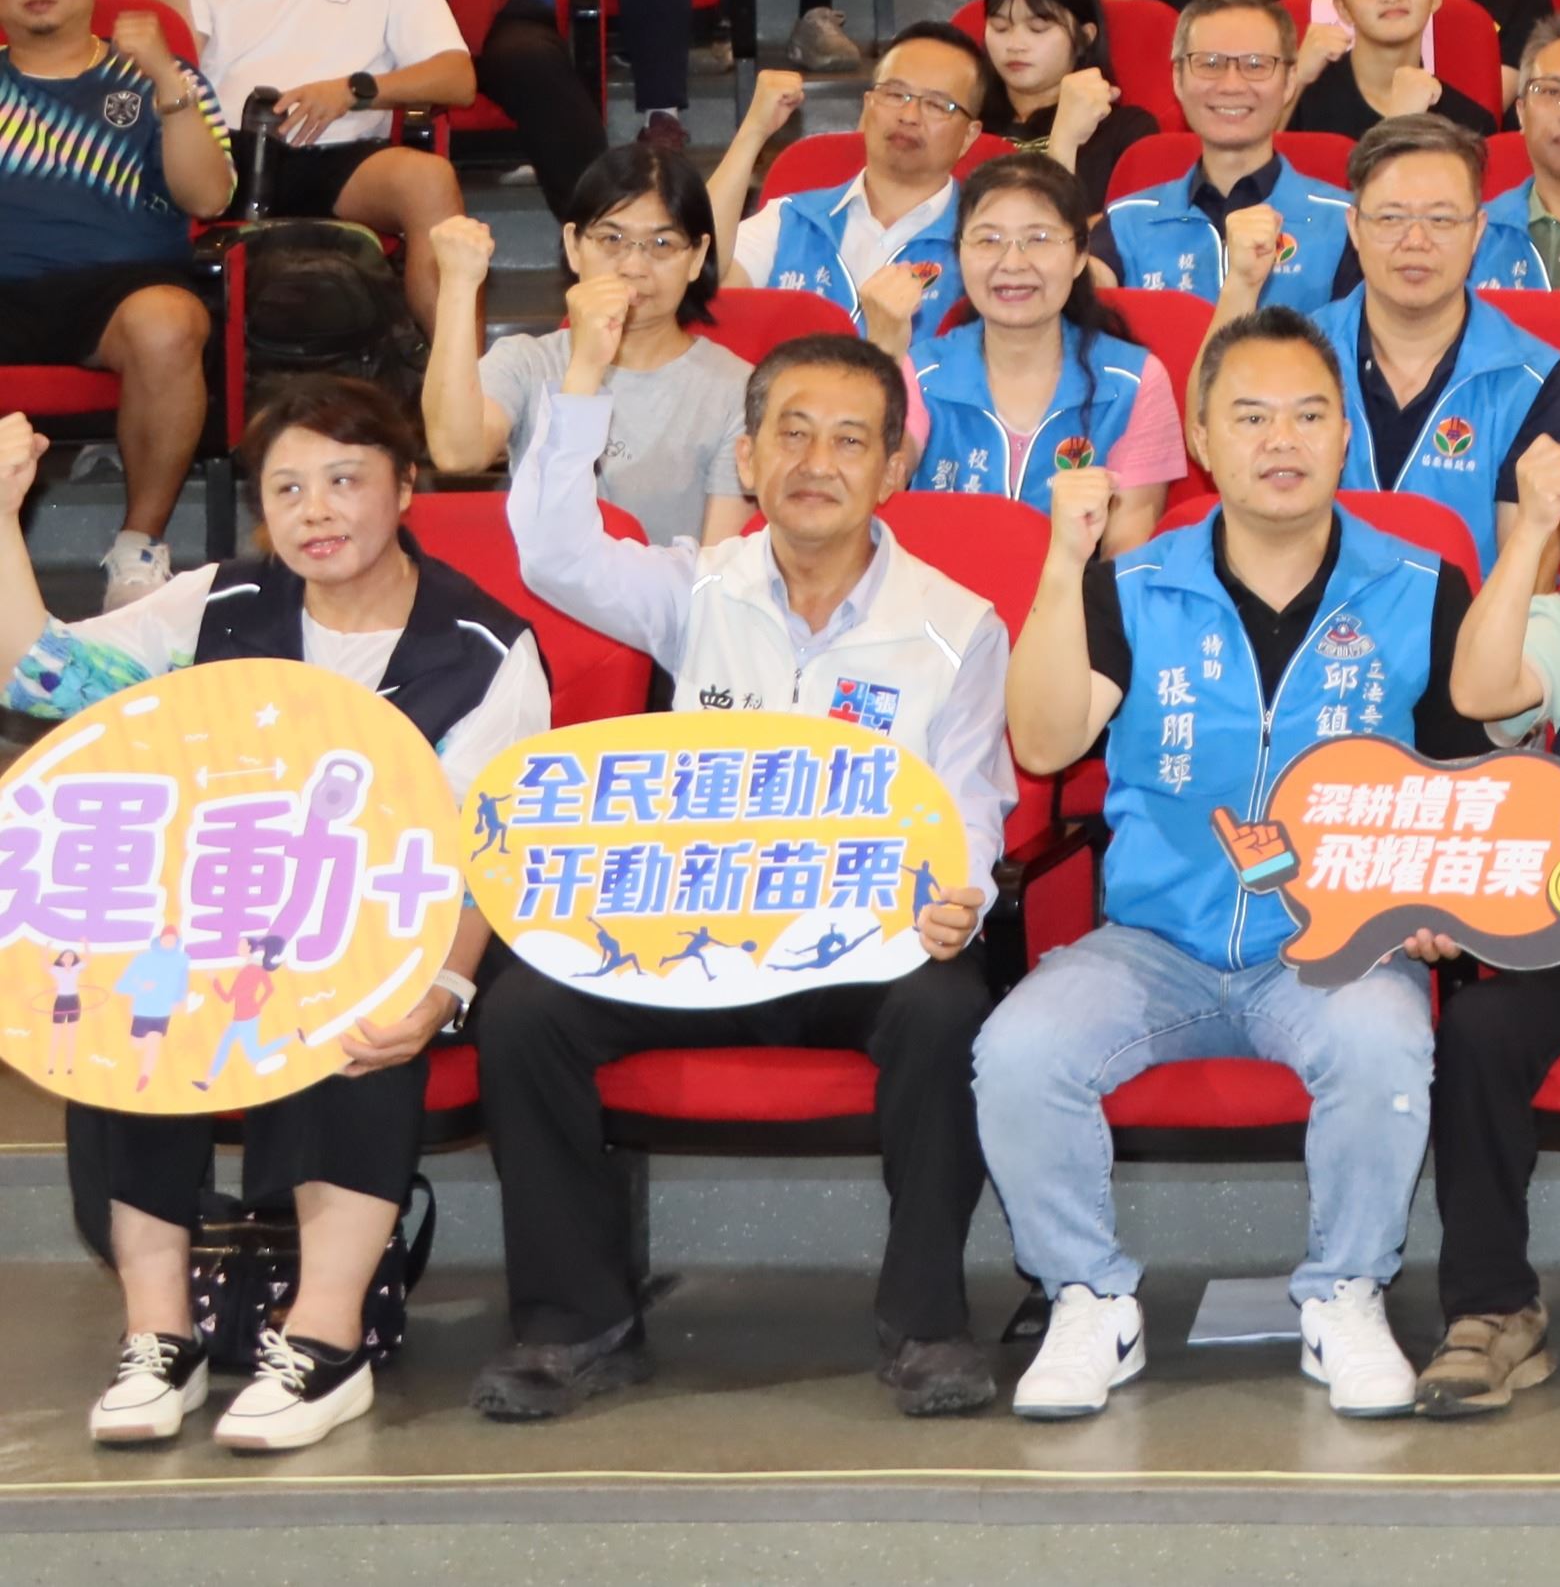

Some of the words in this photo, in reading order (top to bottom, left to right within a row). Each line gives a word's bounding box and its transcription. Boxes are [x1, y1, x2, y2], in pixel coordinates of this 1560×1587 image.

[1177, 253, 1196, 291] 校長
[964, 448, 990, 494] 校長
[1201, 633, 1224, 681] 特助
[1157, 666, 1197, 795] 張朋輝
[1316, 662, 1360, 737] 邱鎮
[1359, 659, 1385, 734] 立法委
[512, 748, 897, 826] 全民運動城
[1304, 776, 1508, 834] 深耕體育
[517, 837, 908, 918] 汗動新苗栗
[1306, 836, 1550, 897] 飛耀苗栗
